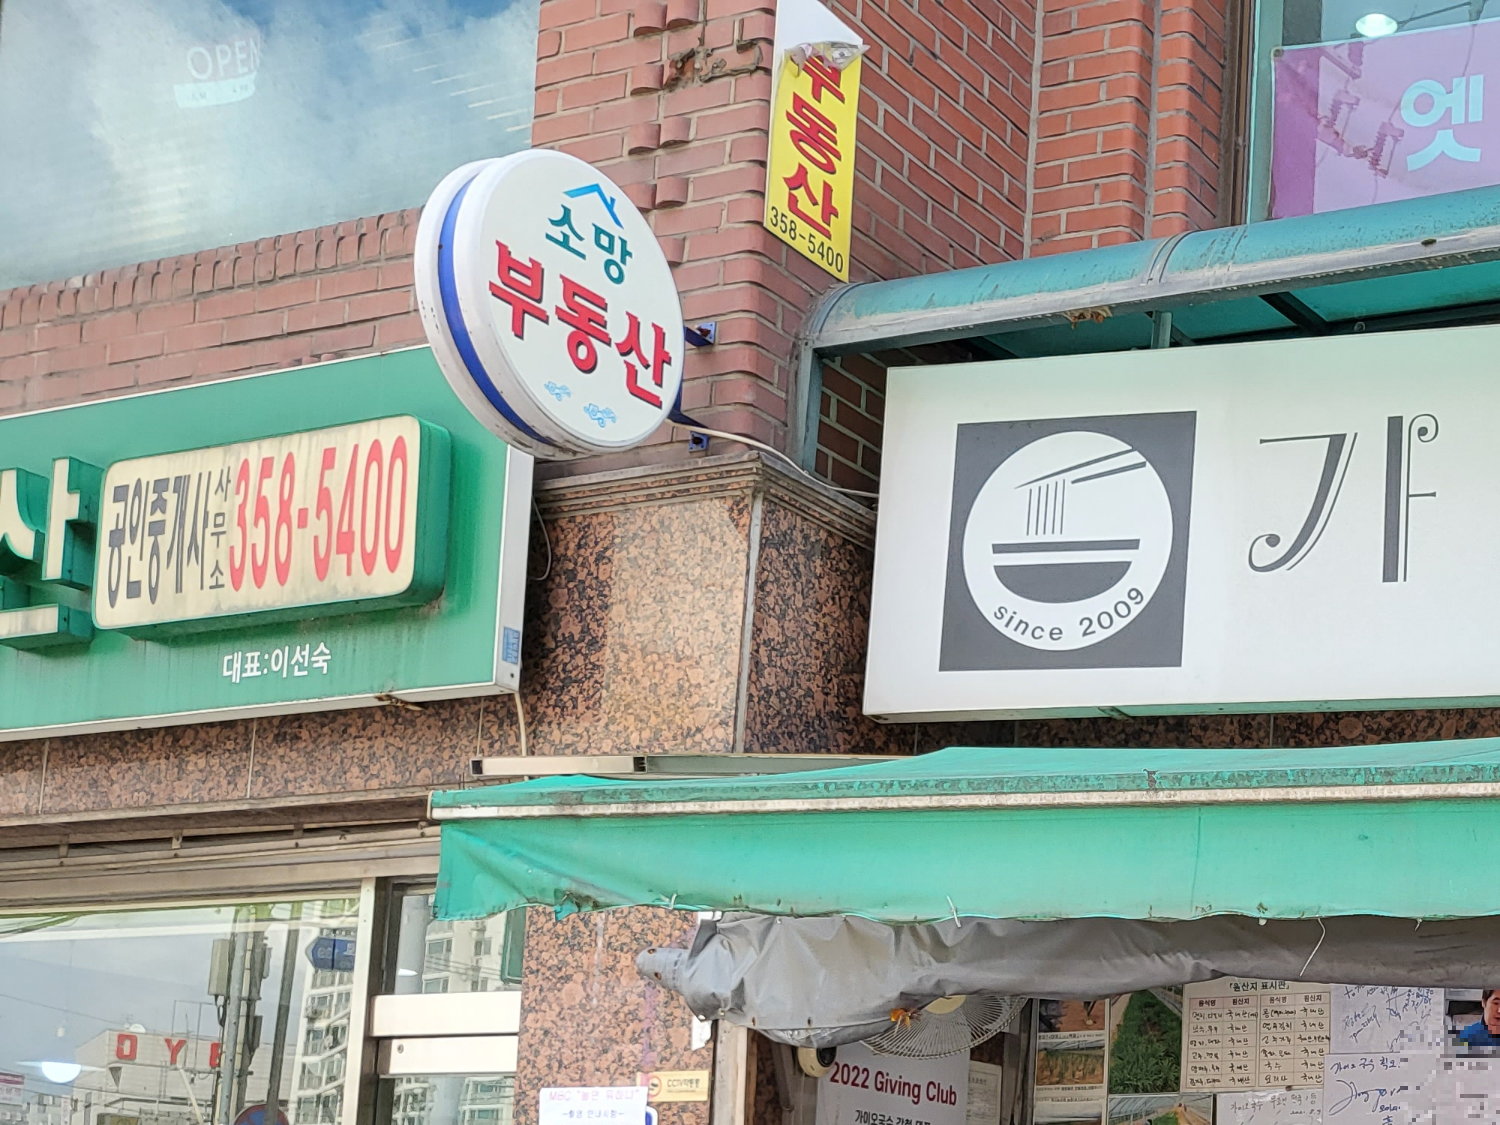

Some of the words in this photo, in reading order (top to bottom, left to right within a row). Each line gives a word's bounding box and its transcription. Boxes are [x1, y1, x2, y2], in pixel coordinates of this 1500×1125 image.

[186, 37, 260, 80] OPEN
[782, 54, 846, 241] 부동산
[544, 203, 633, 285] 소망
[770, 205, 844, 274] 358-5400
[488, 239, 672, 410] 부동산
[107, 469, 211, 609] 공인중개사
[209, 464, 231, 591] 사무소
[229, 435, 408, 593] 358-5400
[991, 601, 1065, 644] since
[1078, 585, 1147, 640] 2009
[222, 641, 332, 684] 대표:이선숙
[829, 1061, 870, 1090] 2022
[874, 1070, 922, 1106] Giving
[926, 1080, 958, 1107] Club
